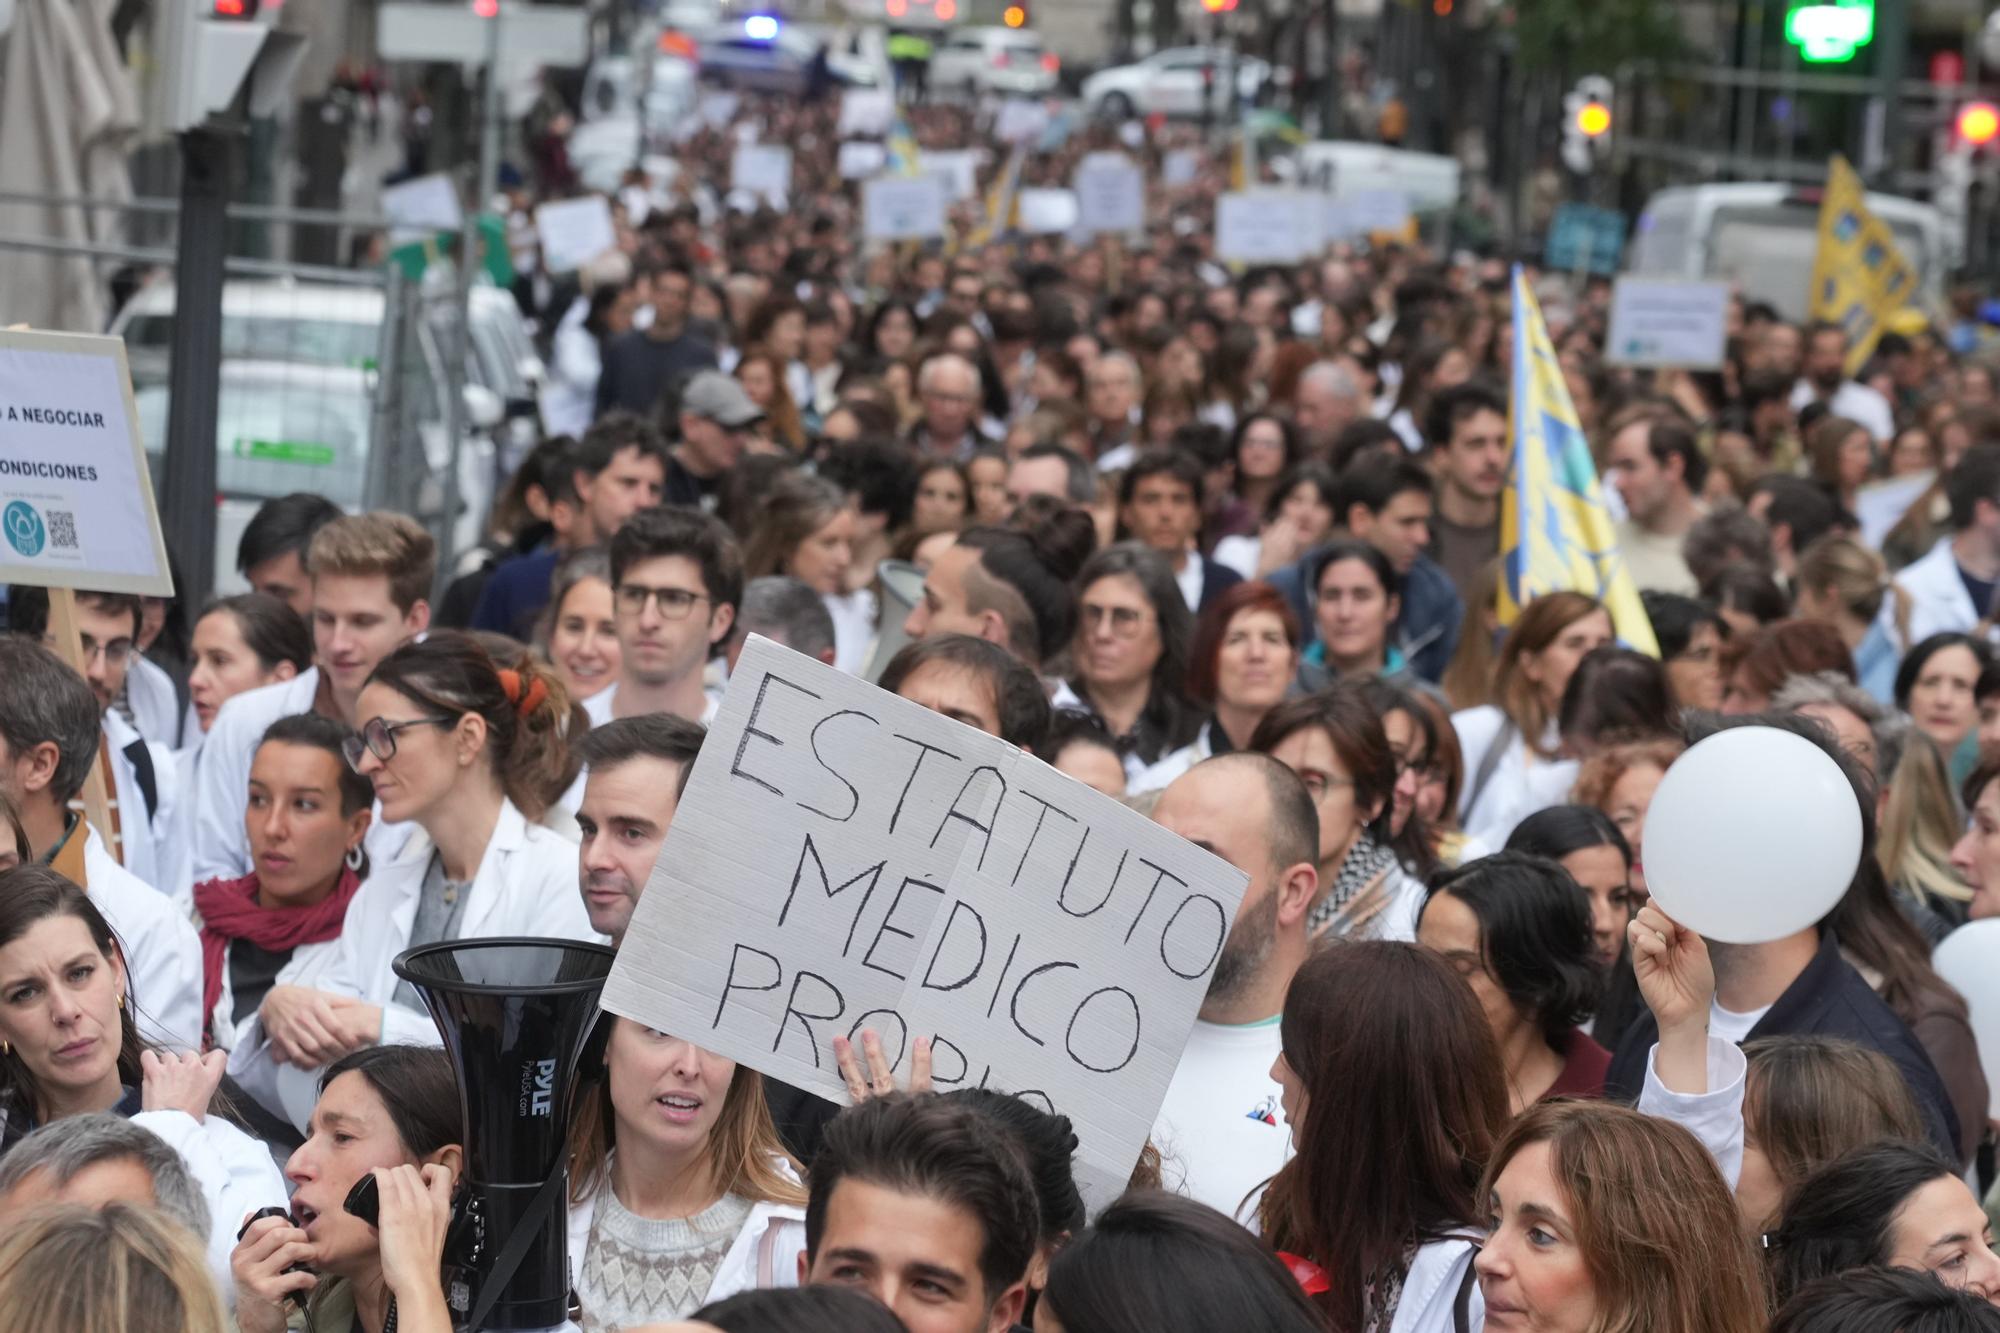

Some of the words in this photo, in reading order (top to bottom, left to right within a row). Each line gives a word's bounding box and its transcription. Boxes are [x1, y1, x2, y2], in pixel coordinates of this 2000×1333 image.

[0, 459, 98, 481] ONDICIONES
[8, 406, 18, 421] A
[22, 407, 105, 428] NEGOCIAR
[730, 671, 1226, 980] ESTATUTO
[777, 832, 1141, 1073] MÉDICO
[712, 943, 1056, 1115] PROP
[532, 1059, 556, 1116] PYLE
